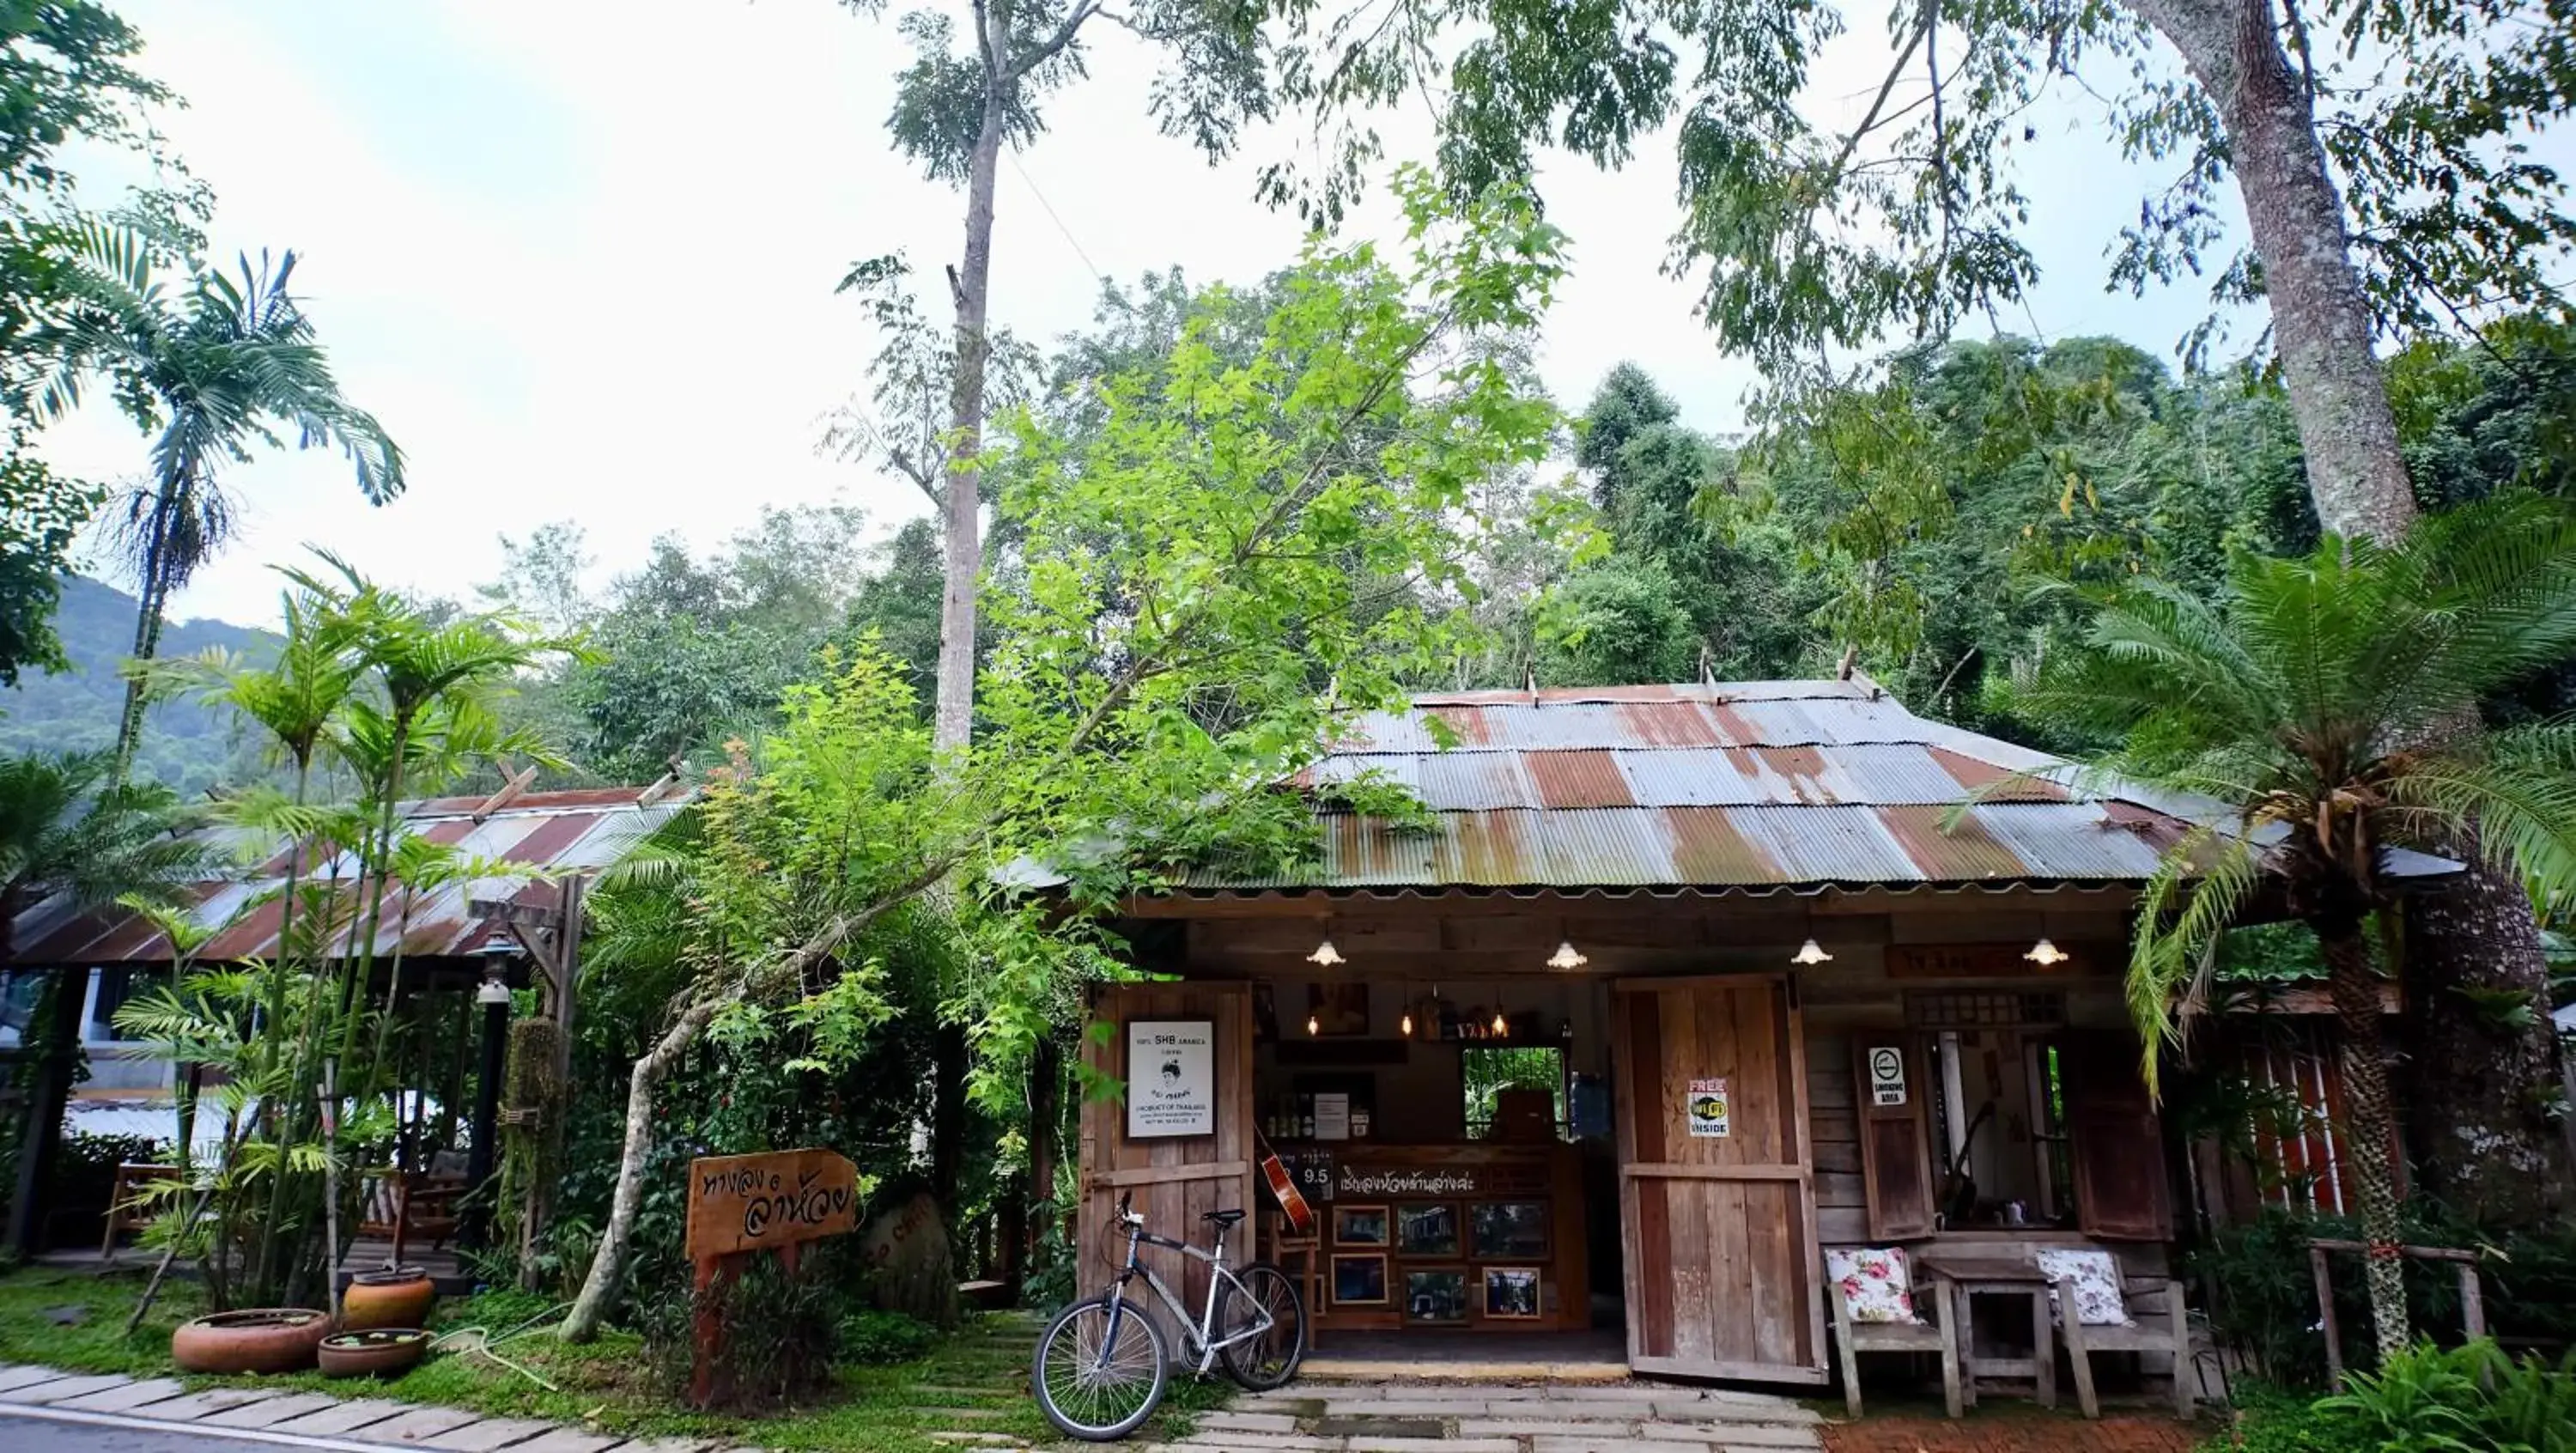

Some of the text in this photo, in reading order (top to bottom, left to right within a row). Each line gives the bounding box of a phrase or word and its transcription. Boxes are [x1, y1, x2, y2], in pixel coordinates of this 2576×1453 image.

[1155, 1035, 1176, 1045] SHB
[1692, 1124, 1726, 1133] INSIDE
[1304, 1169, 1328, 1183] 9.5
